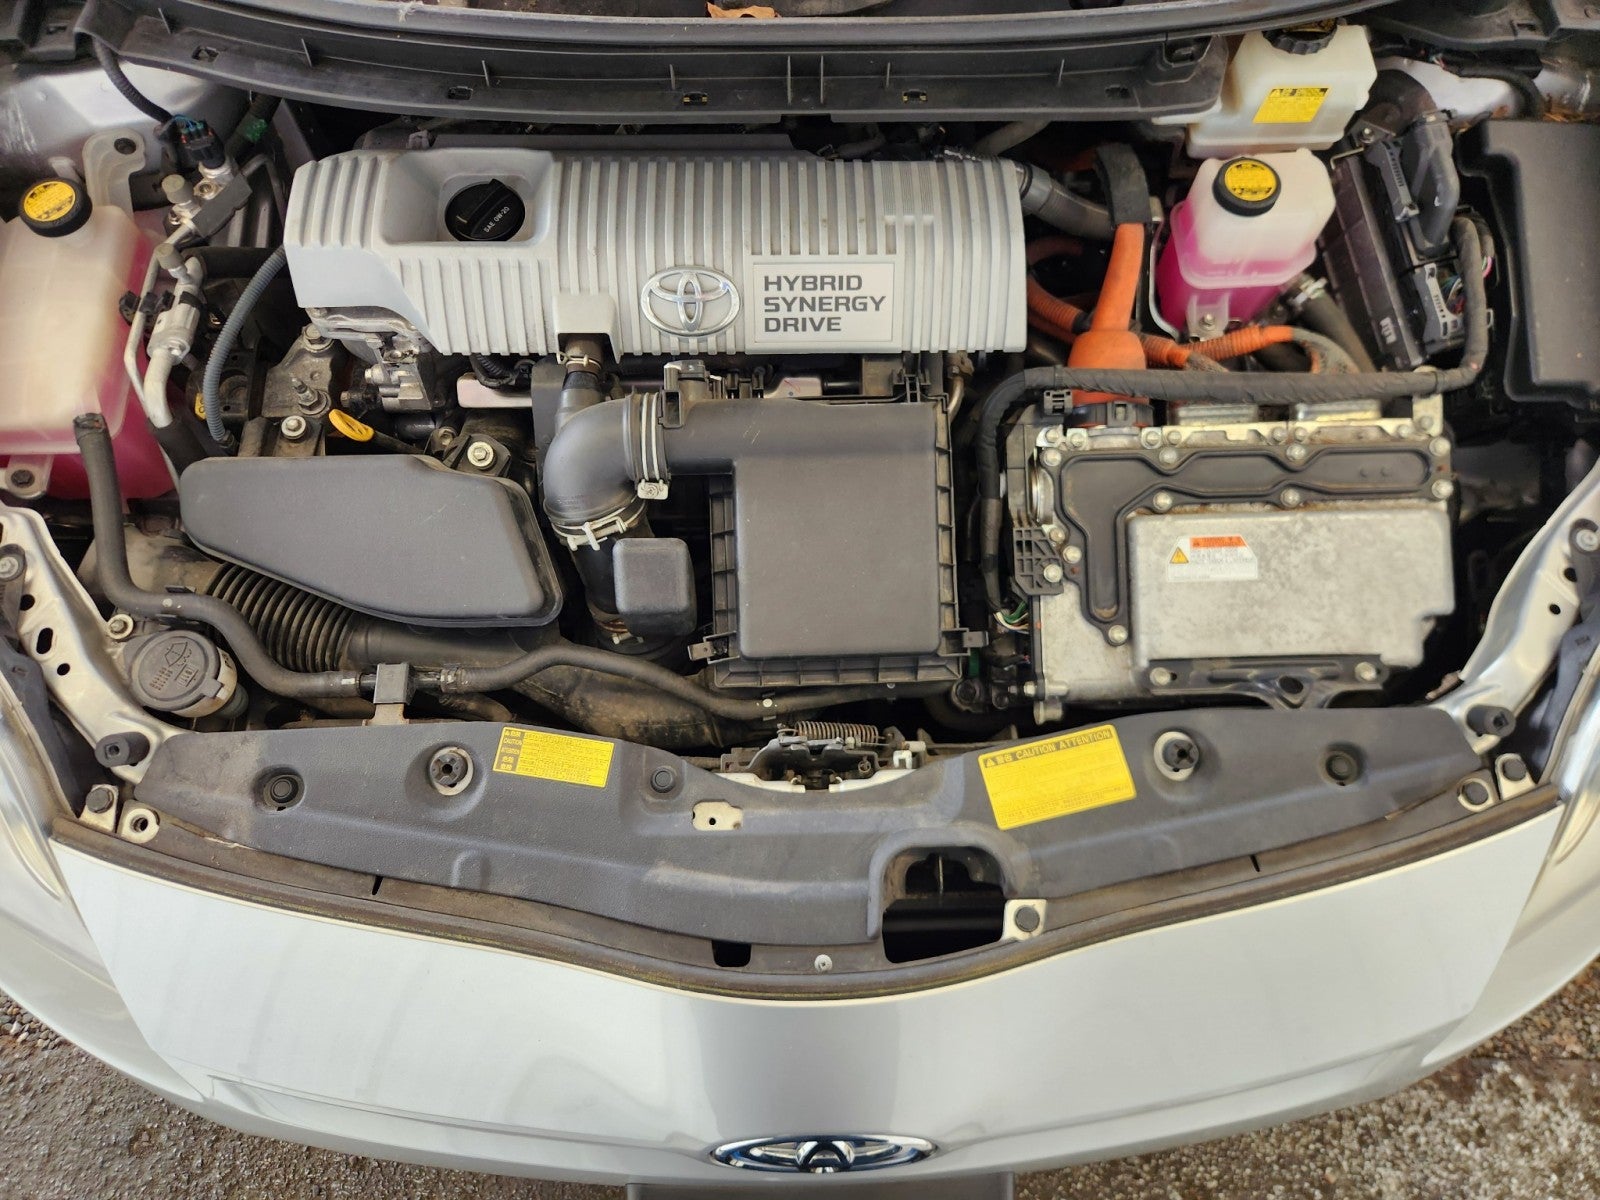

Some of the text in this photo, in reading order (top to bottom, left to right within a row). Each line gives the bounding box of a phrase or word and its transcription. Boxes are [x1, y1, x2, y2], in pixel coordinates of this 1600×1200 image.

[483, 222, 496, 233] SAE
[764, 275, 862, 291] HYBRID
[764, 296, 886, 312] SYNERGY
[764, 317, 841, 332] DRIVE
[503, 737, 523, 746] CAUTION
[1016, 743, 1056, 760] CAUTION
[1059, 730, 1111, 749] ATTENTION
